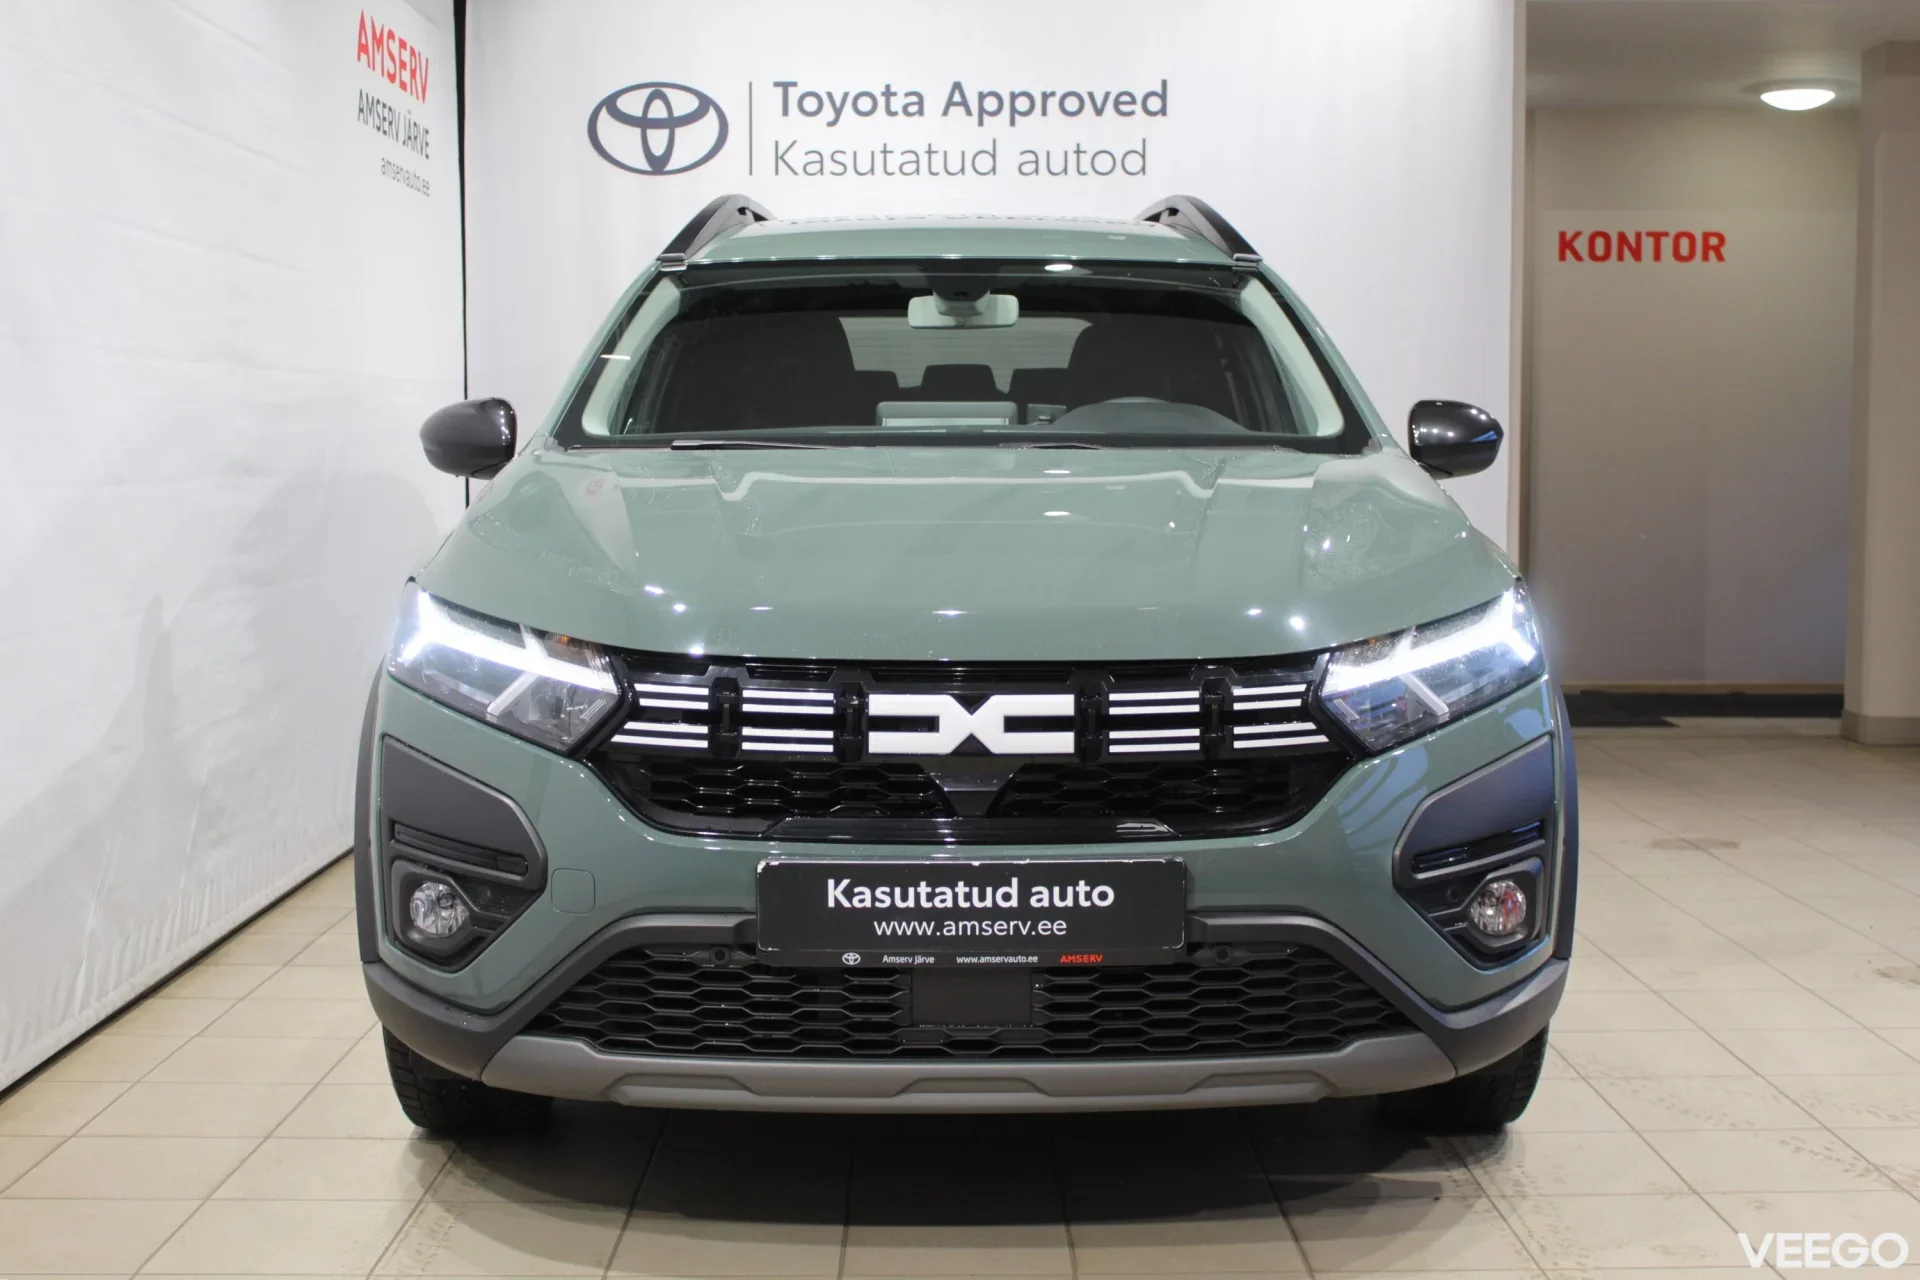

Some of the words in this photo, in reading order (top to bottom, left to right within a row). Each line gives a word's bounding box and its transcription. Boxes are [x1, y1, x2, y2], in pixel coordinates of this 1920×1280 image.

[356, 9, 429, 104] AMSERV
[772, 81, 925, 127] Toyota
[941, 79, 1168, 127] Approved
[357, 88, 401, 143] AMSERV
[402, 109, 430, 160] JÄRVE
[773, 138, 997, 176] Kasutatud
[1017, 138, 1147, 176] autod
[380, 157, 430, 197] amservauto.ee
[1557, 229, 1727, 263] KONTOR
[827, 877, 1018, 908] Kasutatud
[1030, 880, 1115, 908] auto
[873, 919, 1067, 936] www.amserv.ee
[882, 954, 914, 965] Amserv
[914, 954, 935, 966] Järve
[956, 954, 1039, 965] www.amservauto.ee
[1059, 953, 1104, 964] AMSERV
